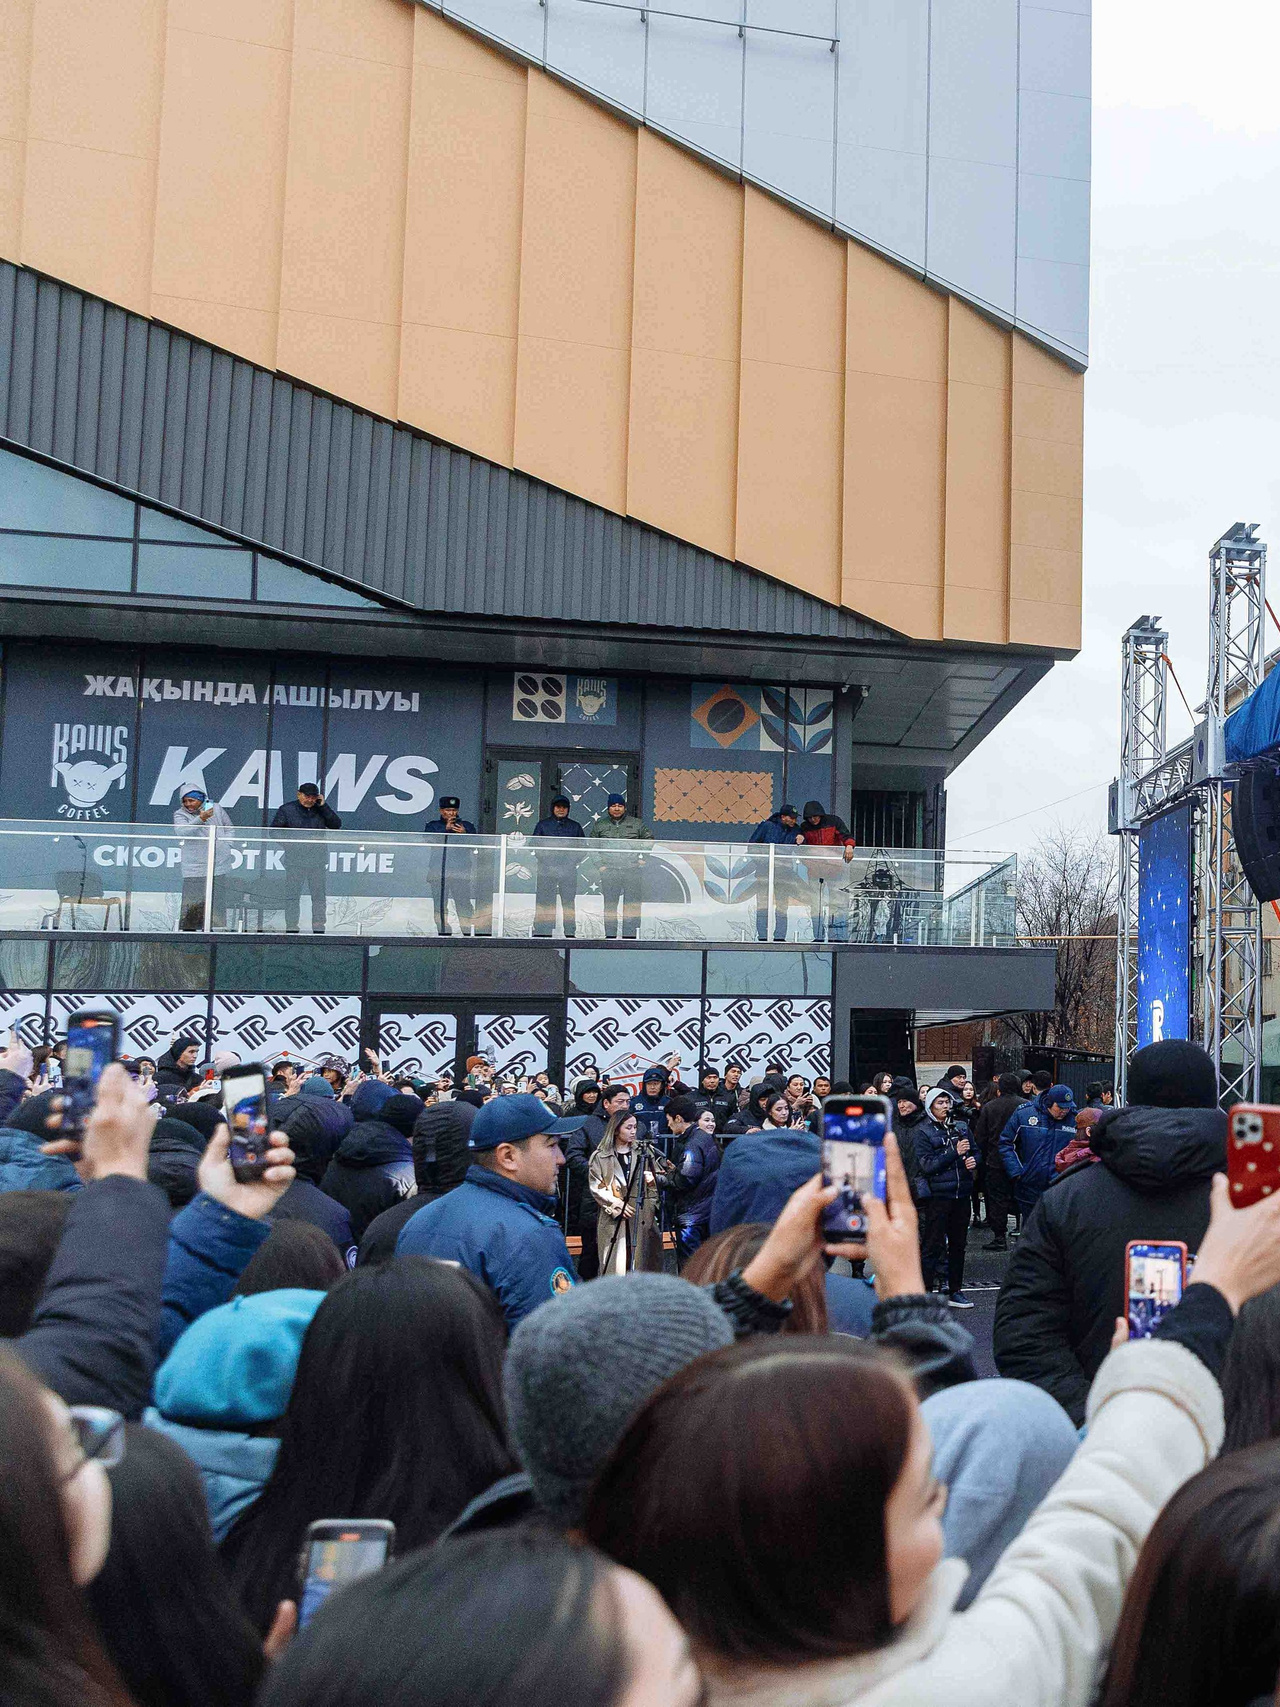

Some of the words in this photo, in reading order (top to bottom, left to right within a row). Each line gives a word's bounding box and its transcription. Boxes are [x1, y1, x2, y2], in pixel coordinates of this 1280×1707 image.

[84, 674, 257, 706] ЖАҚЫНДА
[264, 684, 420, 713] АШЫЛУЫ
[149, 745, 439, 815] KAWS
[57, 803, 110, 820] COFFEE
[93, 844, 182, 868] СКОР
